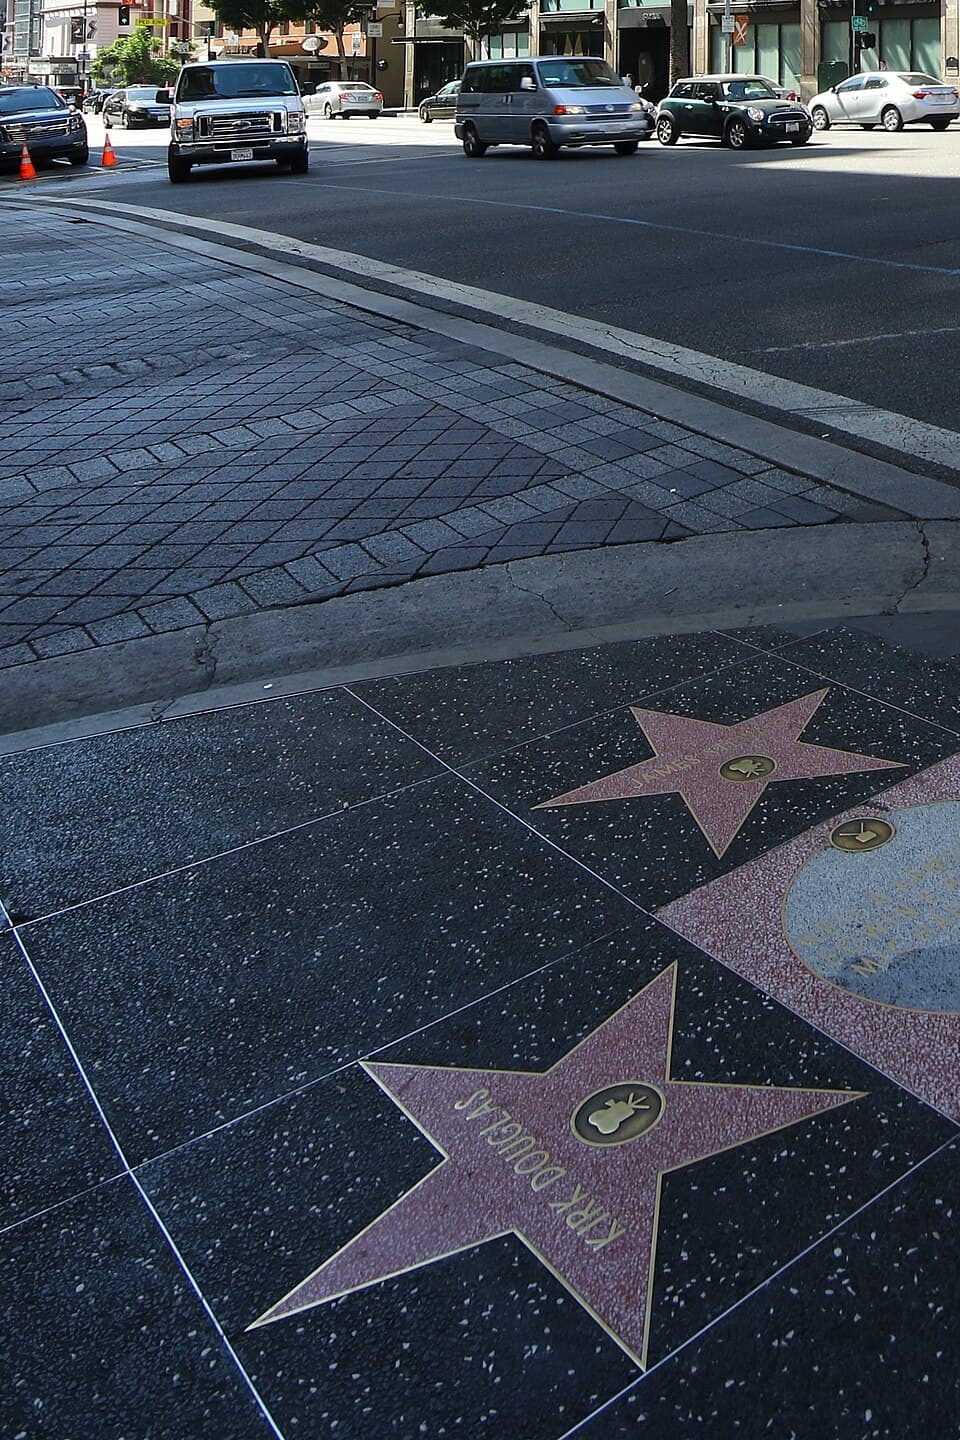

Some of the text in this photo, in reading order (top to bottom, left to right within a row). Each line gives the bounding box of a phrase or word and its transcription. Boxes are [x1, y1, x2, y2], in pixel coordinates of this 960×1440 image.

[625, 753, 703, 790] JAMES
[450, 1084, 629, 1253] KIRK DOUGLAS
